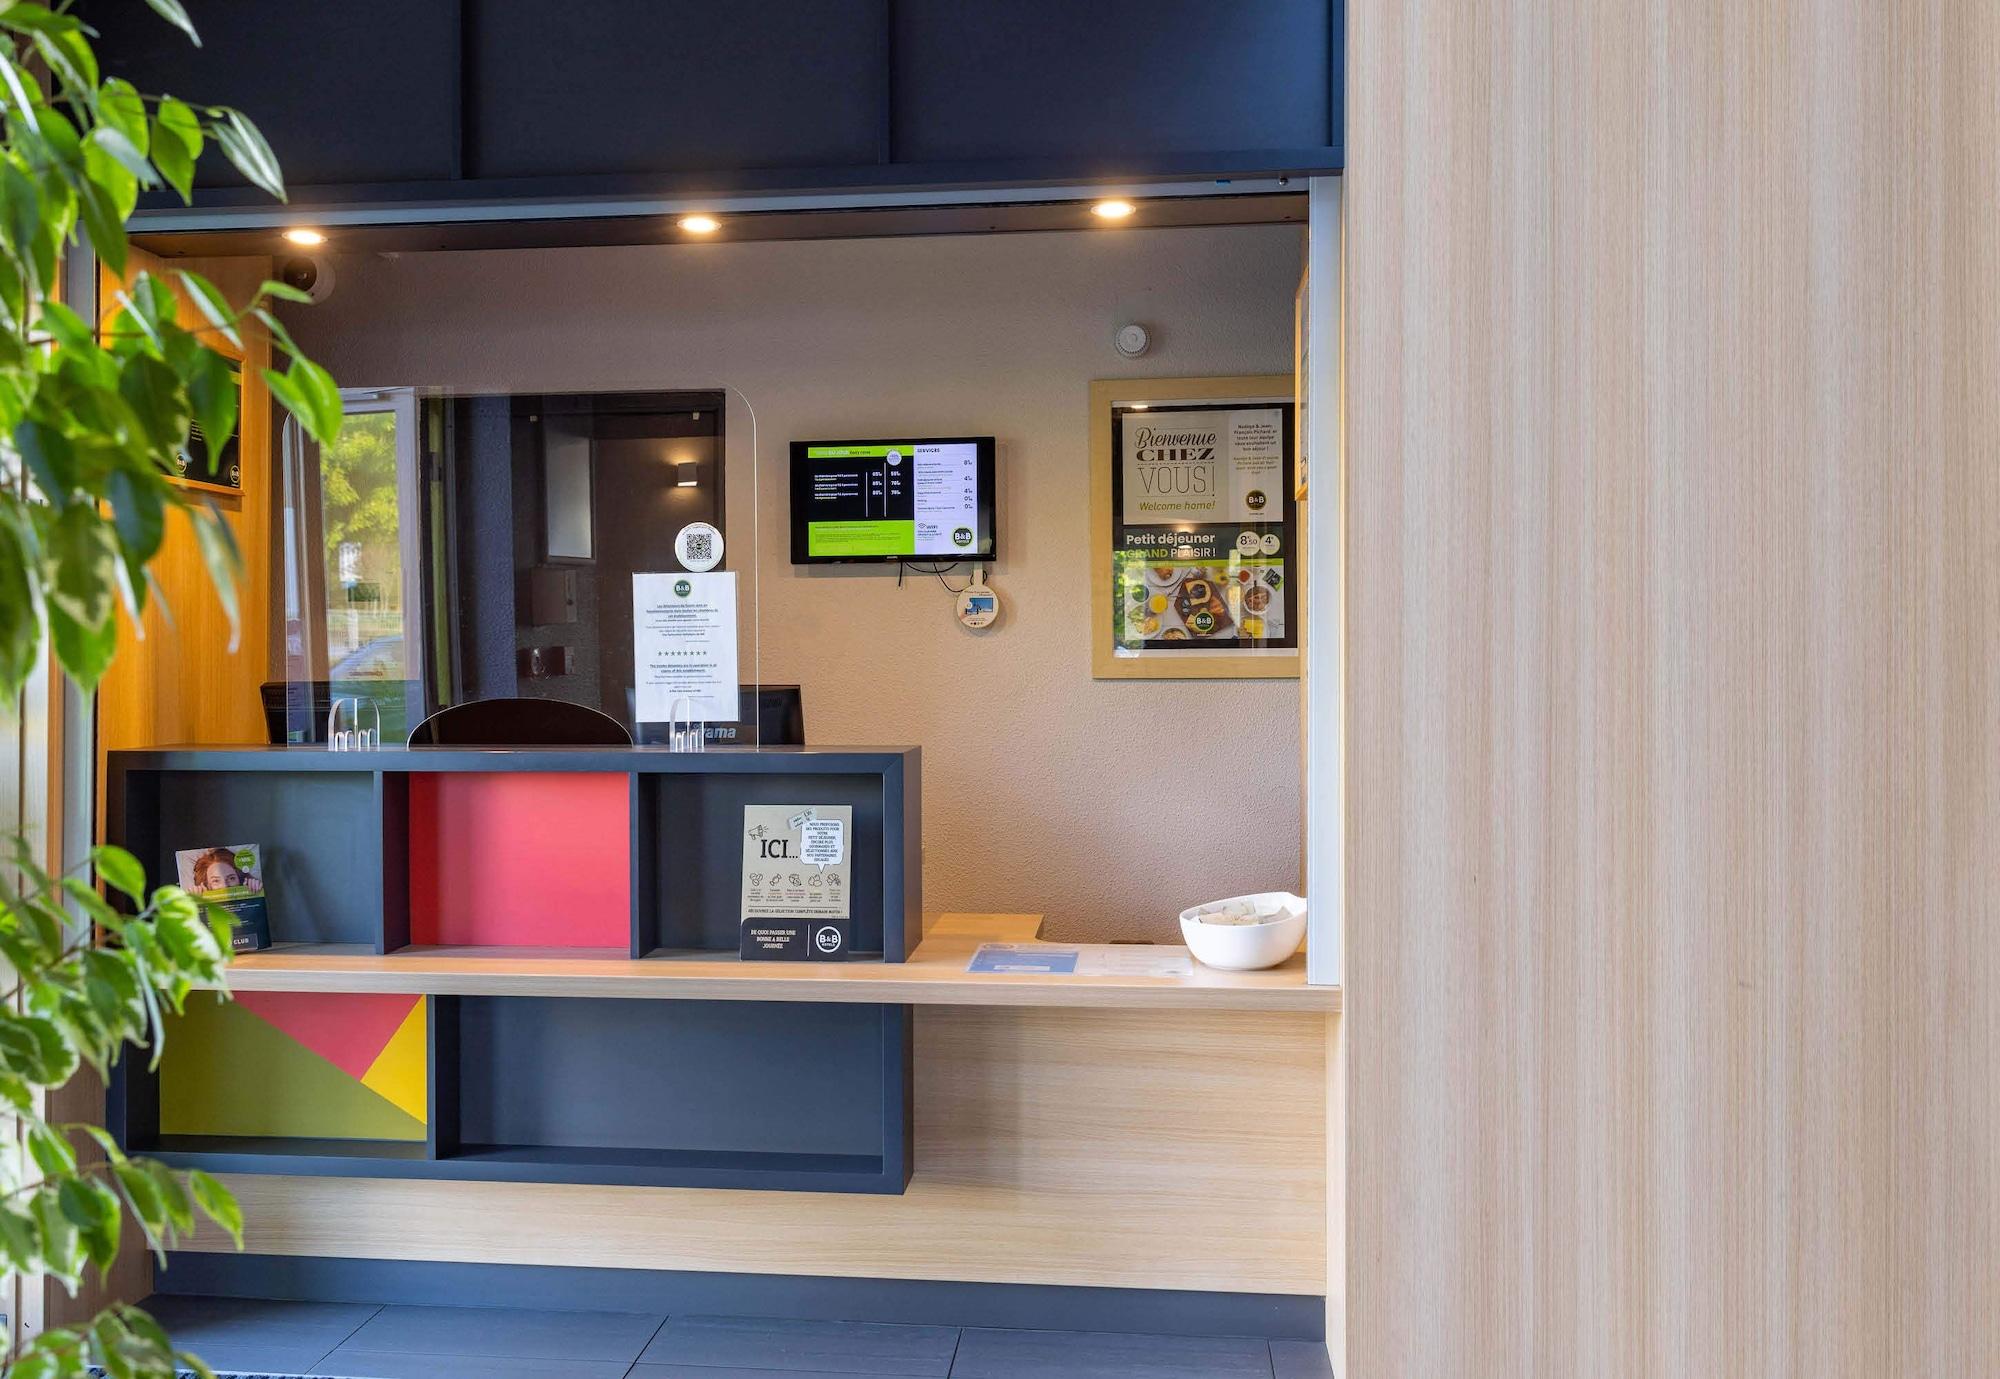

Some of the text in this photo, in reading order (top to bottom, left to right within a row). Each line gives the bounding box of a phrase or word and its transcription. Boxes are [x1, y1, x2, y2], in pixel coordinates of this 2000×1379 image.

[1135, 427, 1216, 449] Bienvenue
[1136, 448, 1215, 461] CHEZ
[1136, 466, 1215, 497] VOUS!
[1249, 496, 1264, 504] B&B
[1139, 500, 1216, 511] Welcome home!
[954, 532, 971, 540] B&B
[1126, 532, 1216, 547] Petit déjeuner
[1127, 549, 1168, 558] GRAND
[675, 584, 690, 592] B&B
[1196, 617, 1212, 625] B&B
[760, 839, 798, 858] ICI...
[819, 934, 839, 943] B&B
